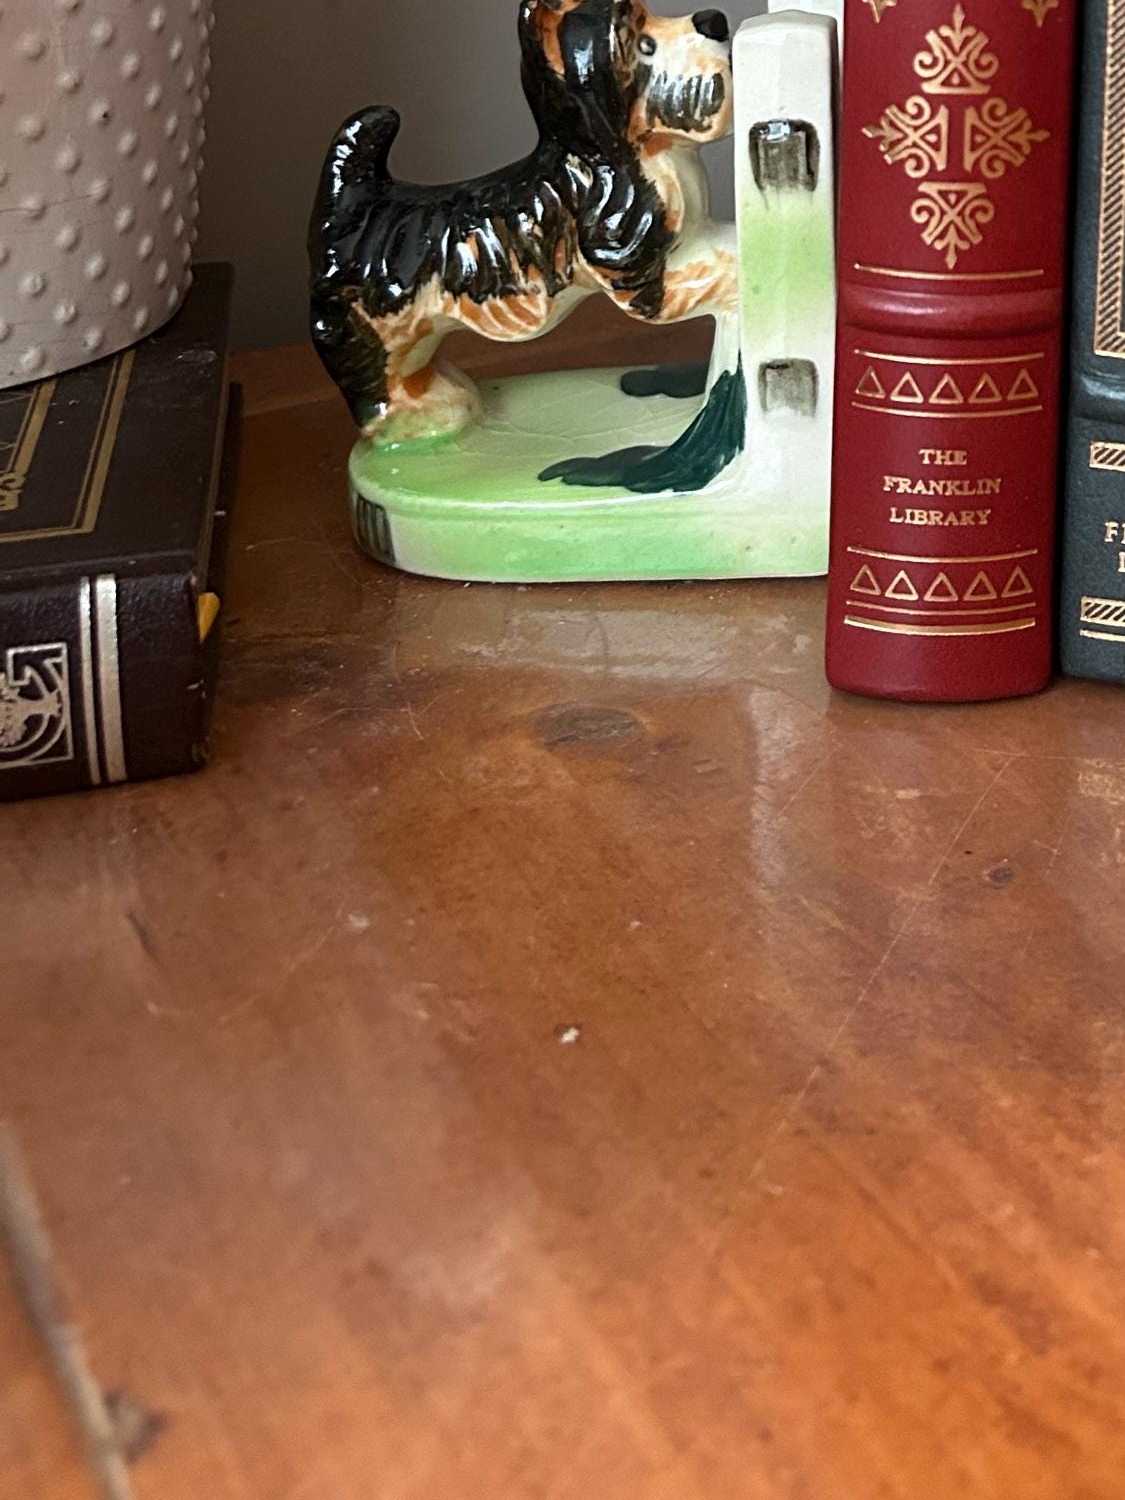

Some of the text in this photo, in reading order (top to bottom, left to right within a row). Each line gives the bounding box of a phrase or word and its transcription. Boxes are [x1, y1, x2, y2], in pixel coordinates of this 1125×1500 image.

[918, 448, 968, 466] THE
[882, 475, 1002, 496] FRANKLIN
[889, 506, 993, 527] LIBRARY
